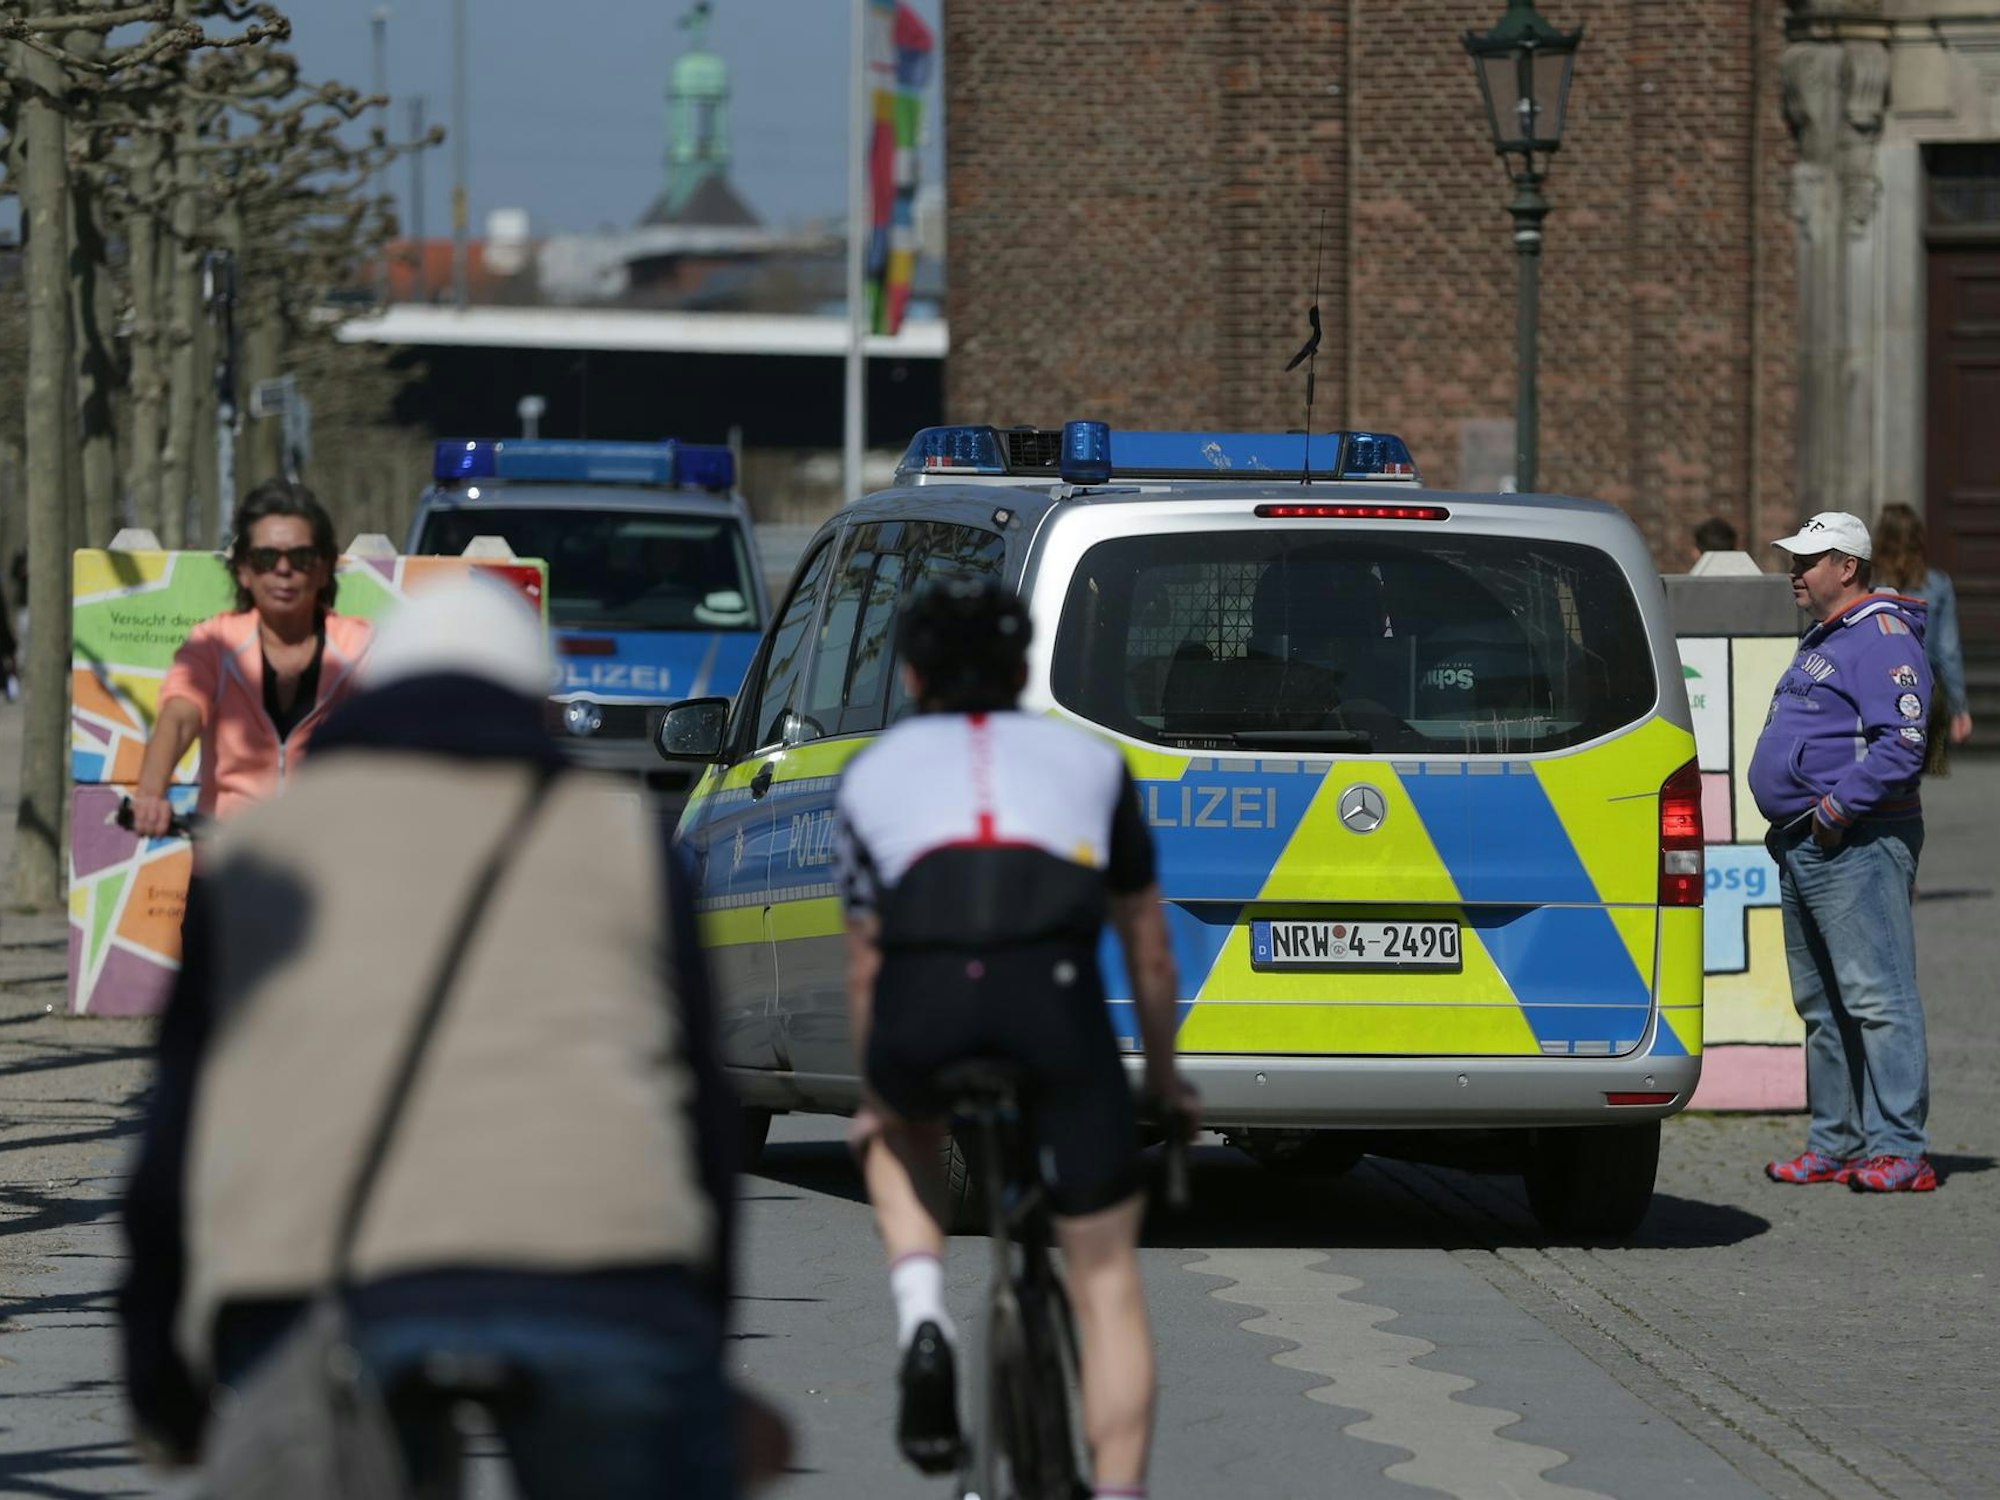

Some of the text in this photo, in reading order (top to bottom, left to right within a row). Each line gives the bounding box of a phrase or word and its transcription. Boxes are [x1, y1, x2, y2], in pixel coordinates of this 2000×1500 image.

[110, 611, 166, 626] Versucht
[1136, 785, 1276, 829] LIZEI
[1272, 926, 1456, 958] NRW 4-2490
